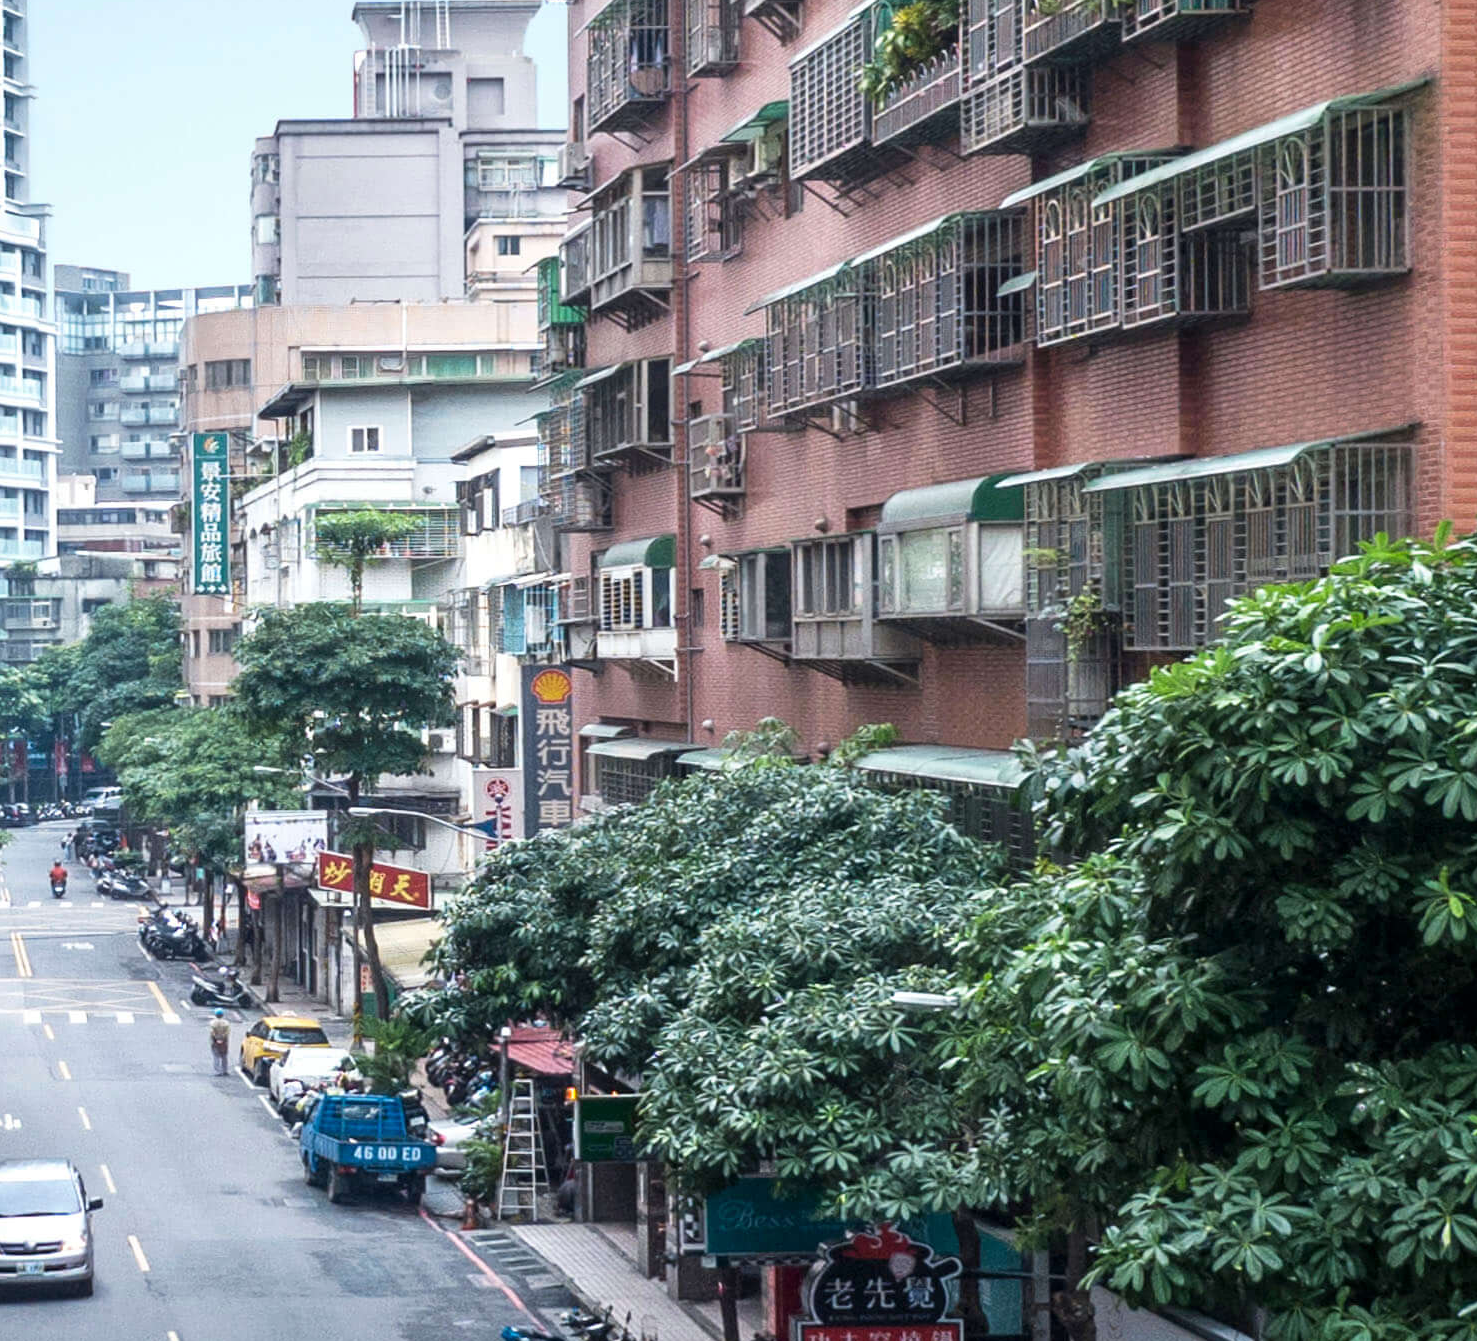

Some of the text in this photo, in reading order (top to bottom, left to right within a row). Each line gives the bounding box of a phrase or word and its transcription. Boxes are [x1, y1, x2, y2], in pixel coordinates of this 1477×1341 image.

[200, 462, 222, 583] 景安精品旅館
[536, 709, 572, 827] 飛行汽車
[824, 1276, 935, 1309] 老先覺
